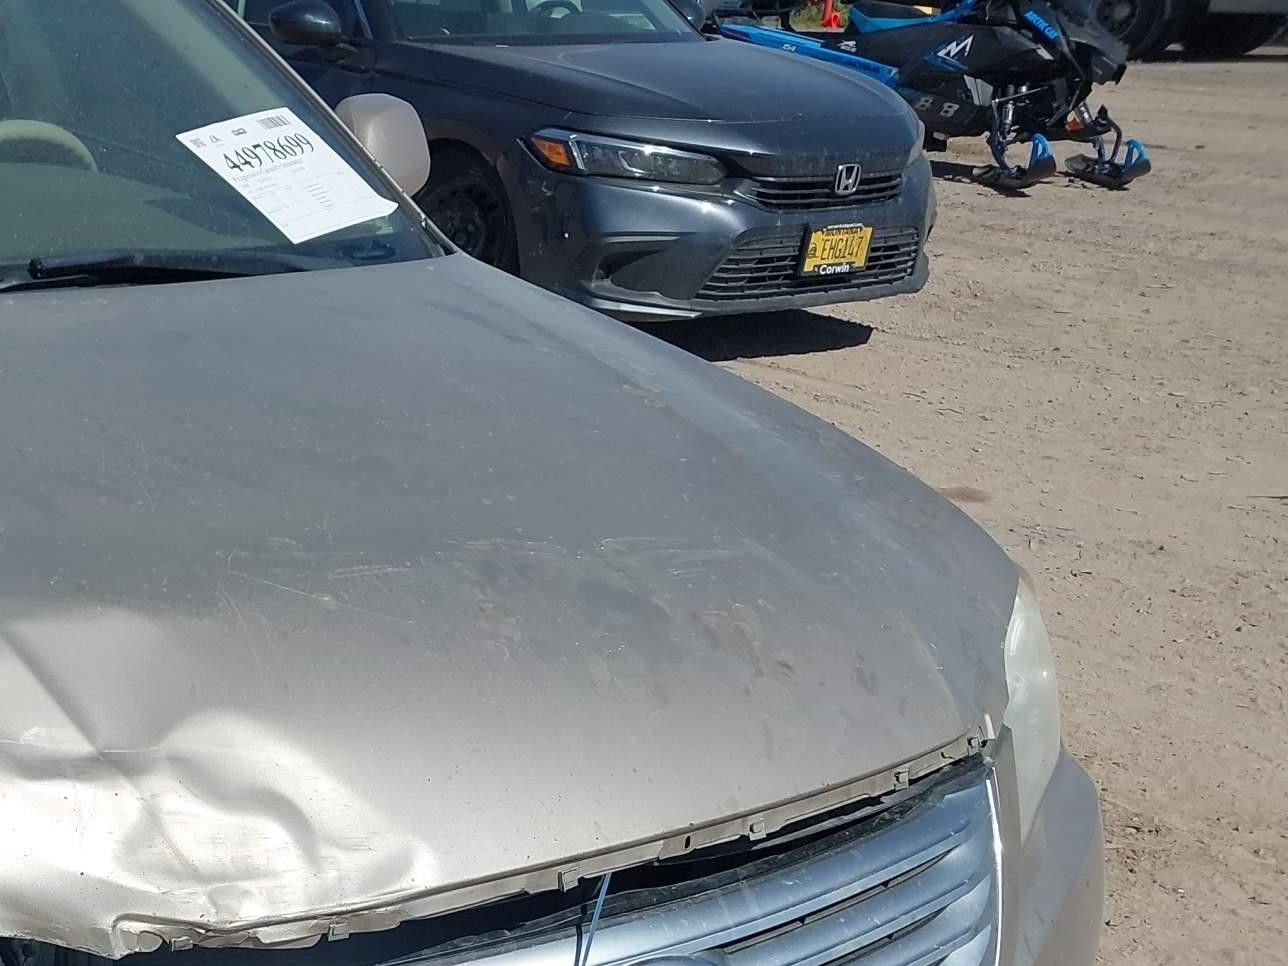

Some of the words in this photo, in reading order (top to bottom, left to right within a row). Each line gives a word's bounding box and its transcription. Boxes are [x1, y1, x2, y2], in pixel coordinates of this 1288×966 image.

[223, 132, 314, 172] 44978699
[821, 236, 864, 260] EHG147
[819, 262, 850, 275] Corwin
